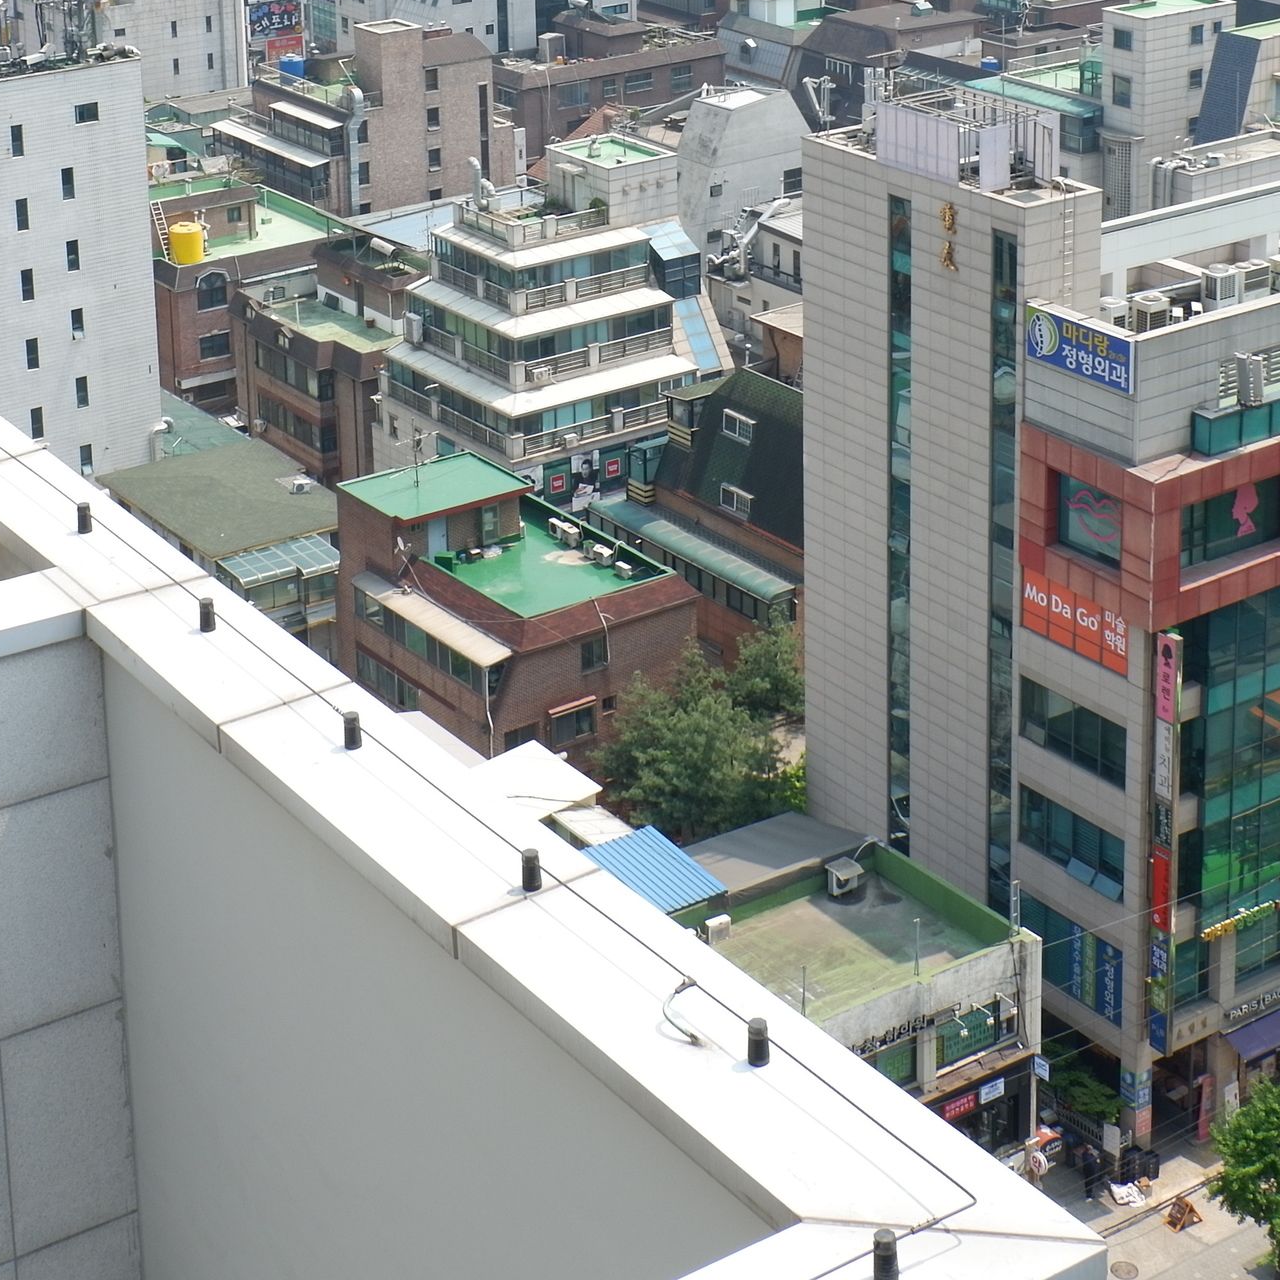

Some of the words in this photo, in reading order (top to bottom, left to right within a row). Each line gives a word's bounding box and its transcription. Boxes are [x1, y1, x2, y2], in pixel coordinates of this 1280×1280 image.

[1062, 322, 1110, 357] 마디랑
[1061, 344, 1128, 389] 정형외과
[1024, 583, 1048, 607] Mo
[1051, 594, 1072, 620] Da
[1076, 607, 1099, 632] Go
[1104, 610, 1127, 636] 미술
[1104, 629, 1126, 656] 학원
[1230, 1000, 1258, 1020] PARIS
